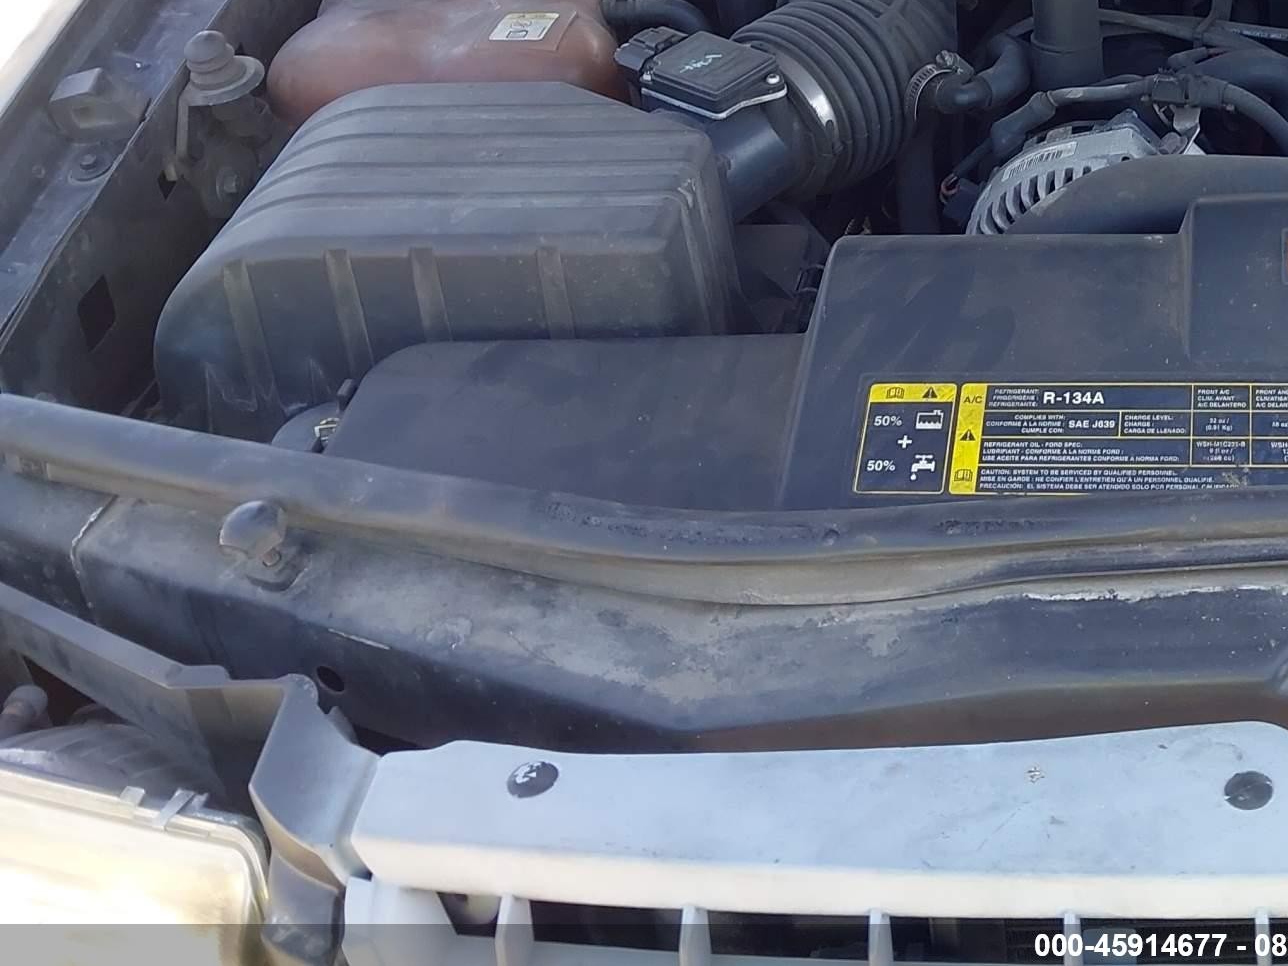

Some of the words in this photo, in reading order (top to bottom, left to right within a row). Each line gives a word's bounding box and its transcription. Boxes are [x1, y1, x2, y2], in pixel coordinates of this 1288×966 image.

[963, 396, 983, 404] A/C
[1042, 391, 1105, 405] R-134A
[873, 416, 903, 426] 50%
[1068, 420, 1090, 428] SAE
[866, 460, 896, 471] 50%
